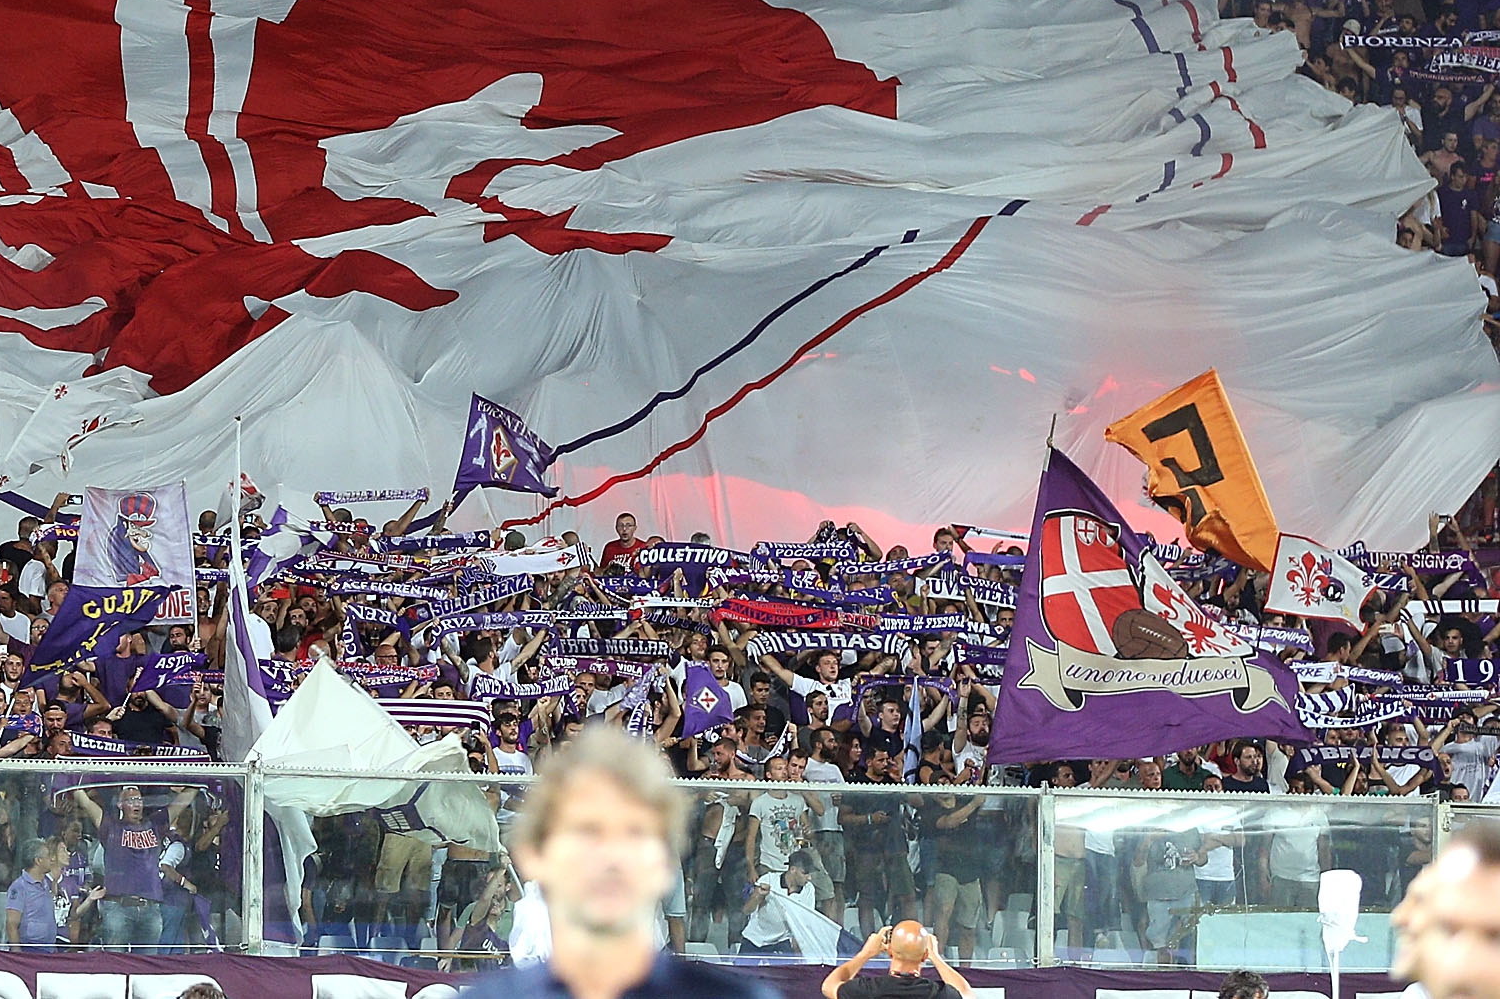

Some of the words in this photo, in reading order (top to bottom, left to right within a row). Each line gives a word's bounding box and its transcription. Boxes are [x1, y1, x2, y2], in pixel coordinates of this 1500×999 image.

[640, 546, 730, 565] COLLETTIVO
[342, 581, 370, 591] ACF
[606, 638, 670, 656] MOLLAR
[783, 633, 882, 650] ULTRAS
[617, 662, 643, 676] VIOLA
[1065, 660, 1243, 688] unonoveduesei
